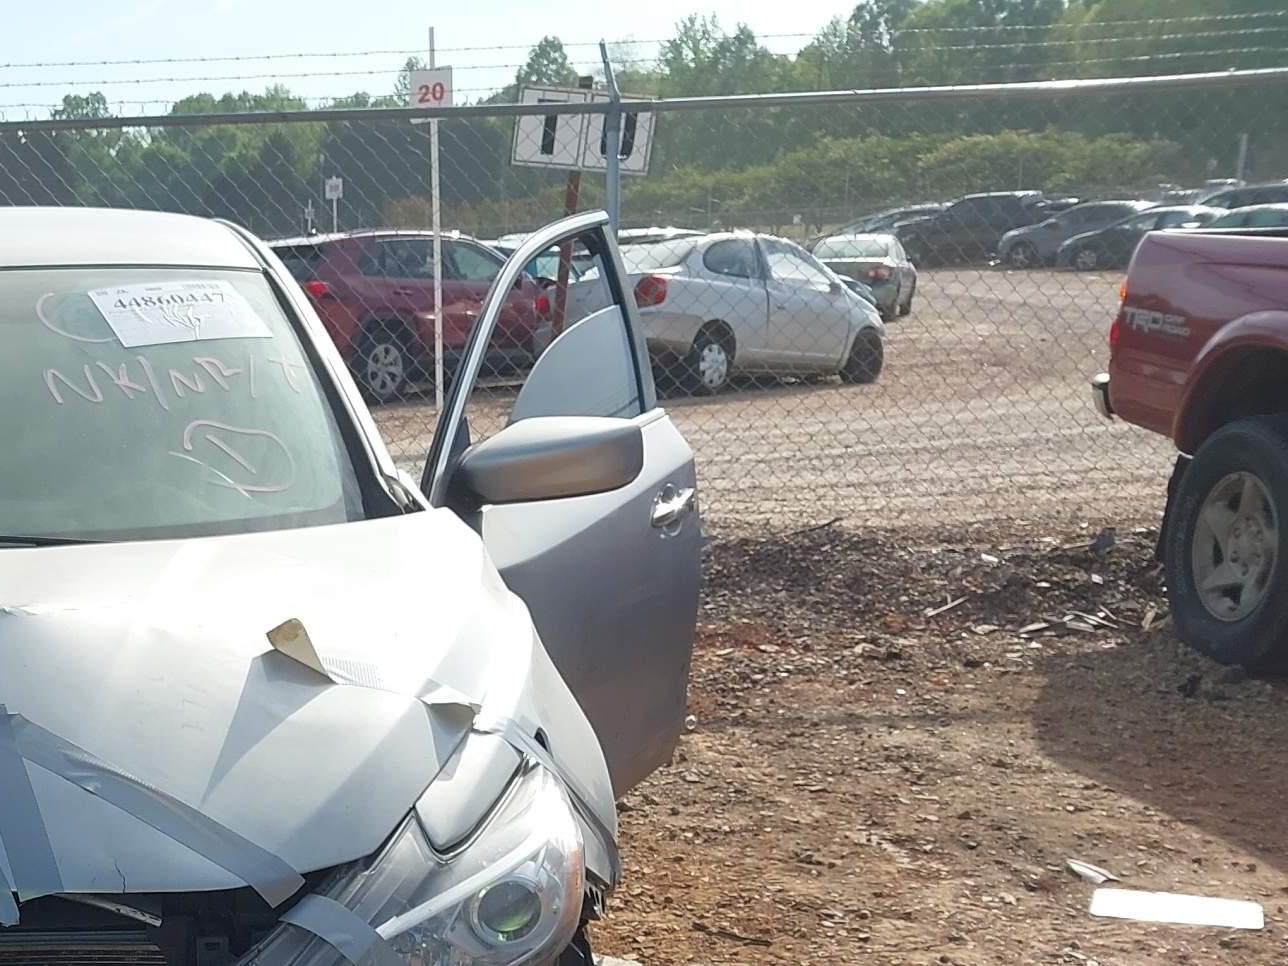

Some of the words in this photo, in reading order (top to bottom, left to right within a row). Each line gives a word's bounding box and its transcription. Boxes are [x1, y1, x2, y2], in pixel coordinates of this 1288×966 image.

[418, 82, 445, 104] 20
[113, 291, 225, 310] 44860447
[1123, 306, 1164, 334] TRD
